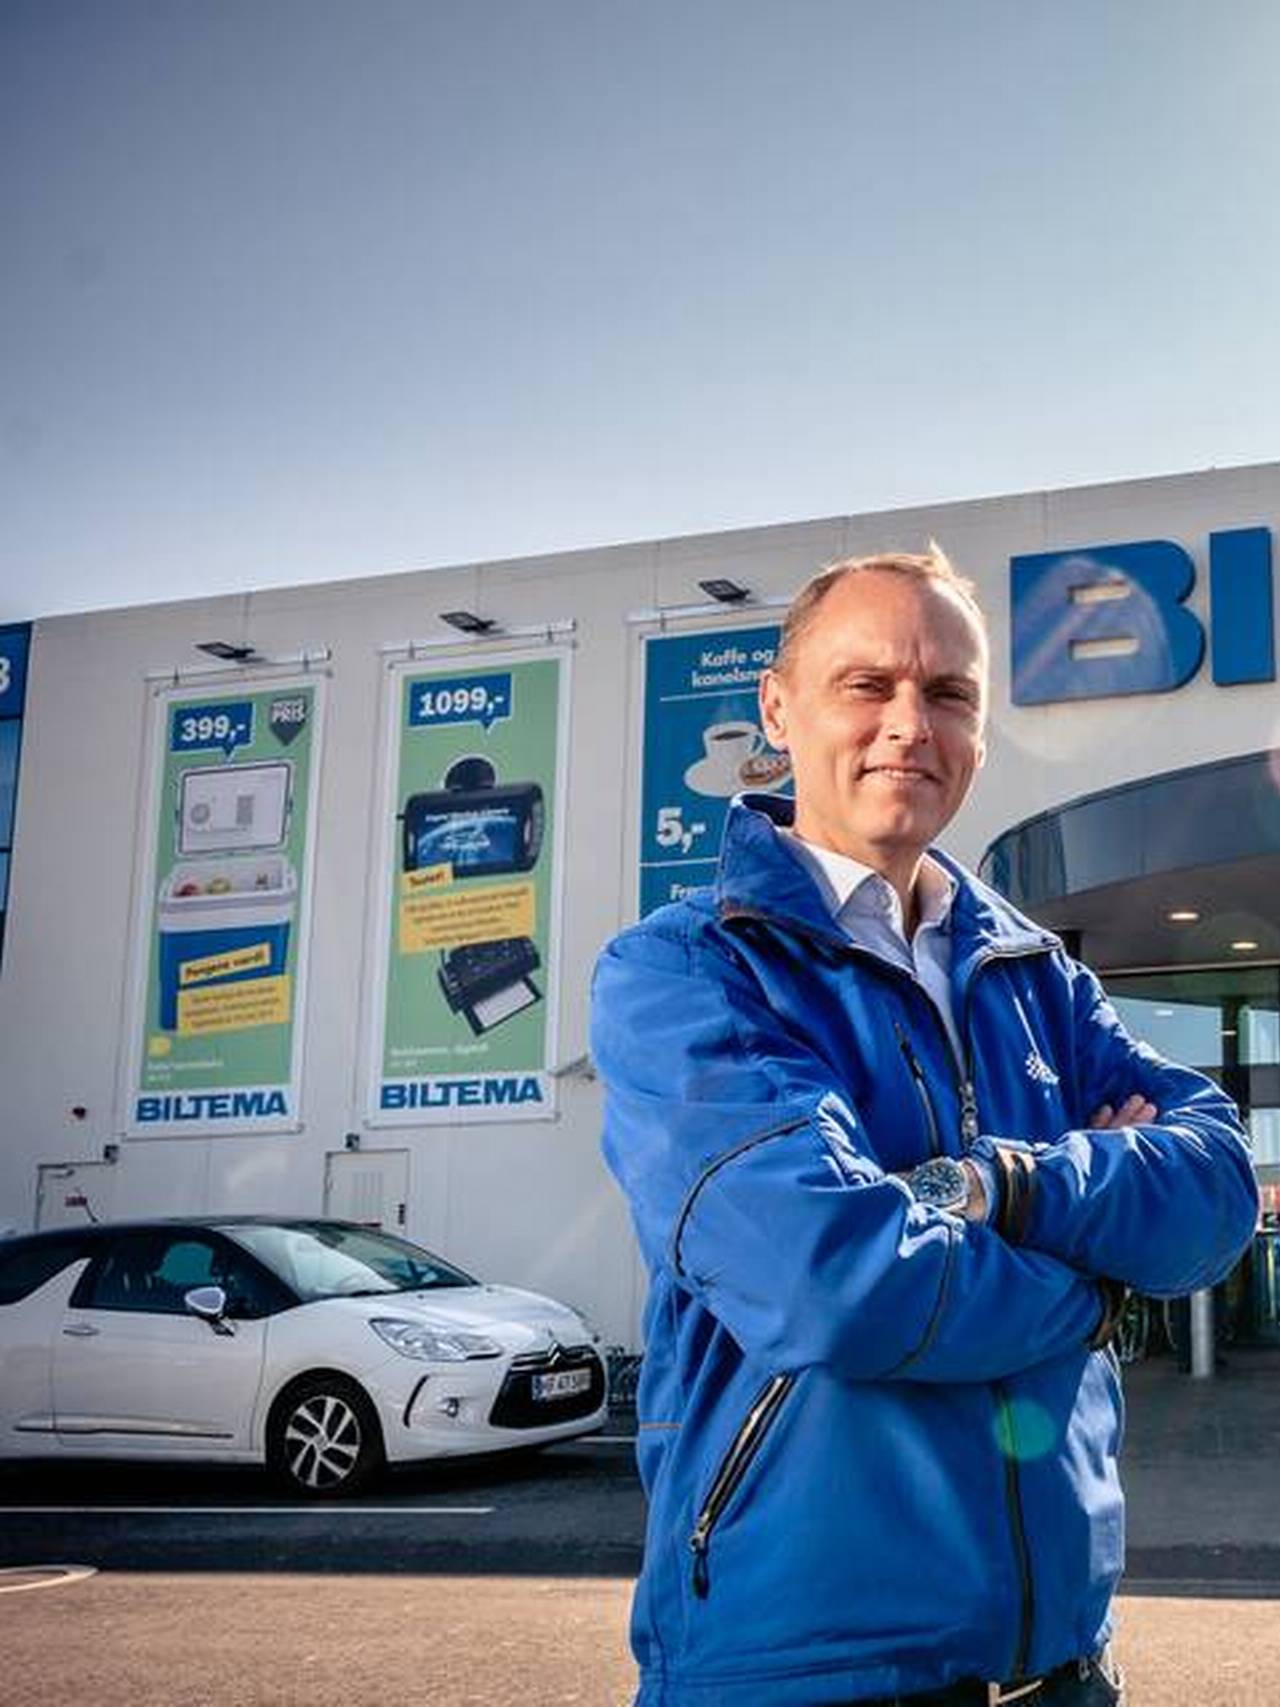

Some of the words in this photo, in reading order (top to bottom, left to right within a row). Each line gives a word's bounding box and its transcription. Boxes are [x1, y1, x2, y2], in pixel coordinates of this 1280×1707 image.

[702, 648, 747, 667] Kaffe
[752, 649, 775, 667] og
[692, 668, 760, 688] kanelsn
[418, 686, 504, 717] 1099,-
[181, 714, 246, 743] 399,-
[656, 806, 706, 854] 5,-
[136, 1090, 288, 1122] BILTEMA
[380, 1078, 543, 1110] BILTEMA
